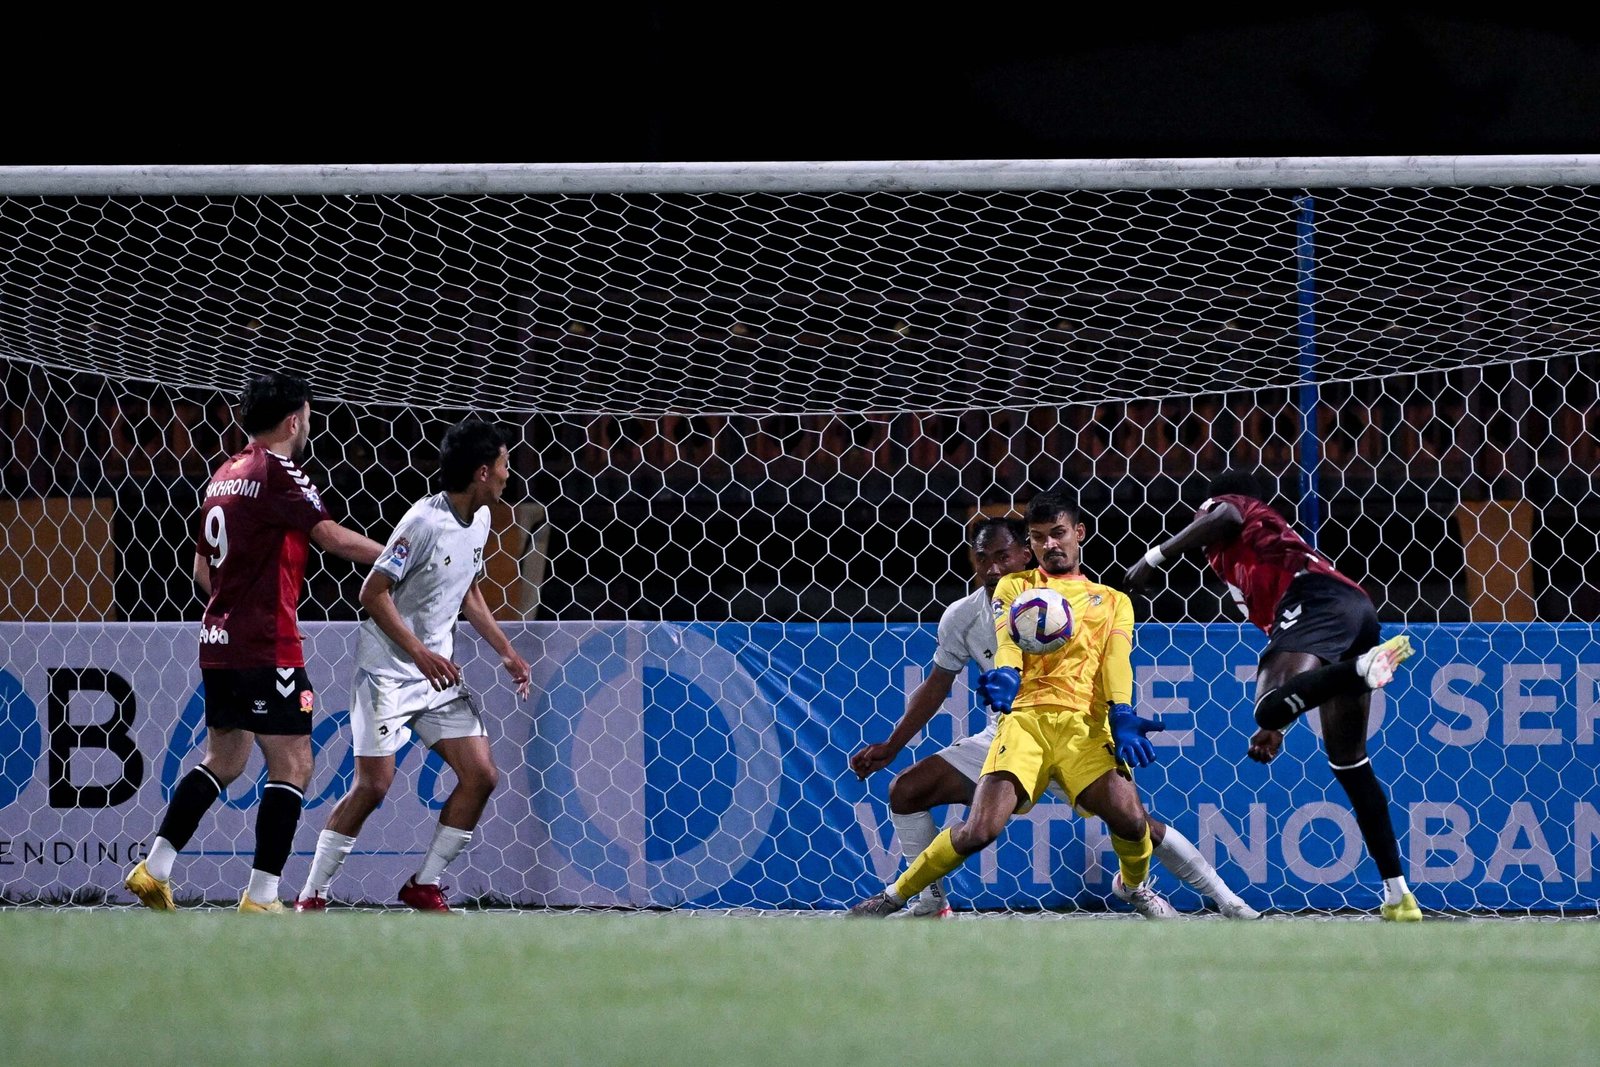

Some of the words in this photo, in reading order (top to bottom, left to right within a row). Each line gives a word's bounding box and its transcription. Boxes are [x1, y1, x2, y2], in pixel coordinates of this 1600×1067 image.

[204, 505, 228, 568] 9
[904, 665, 1196, 747] HE
[1199, 801, 1364, 884] NO
